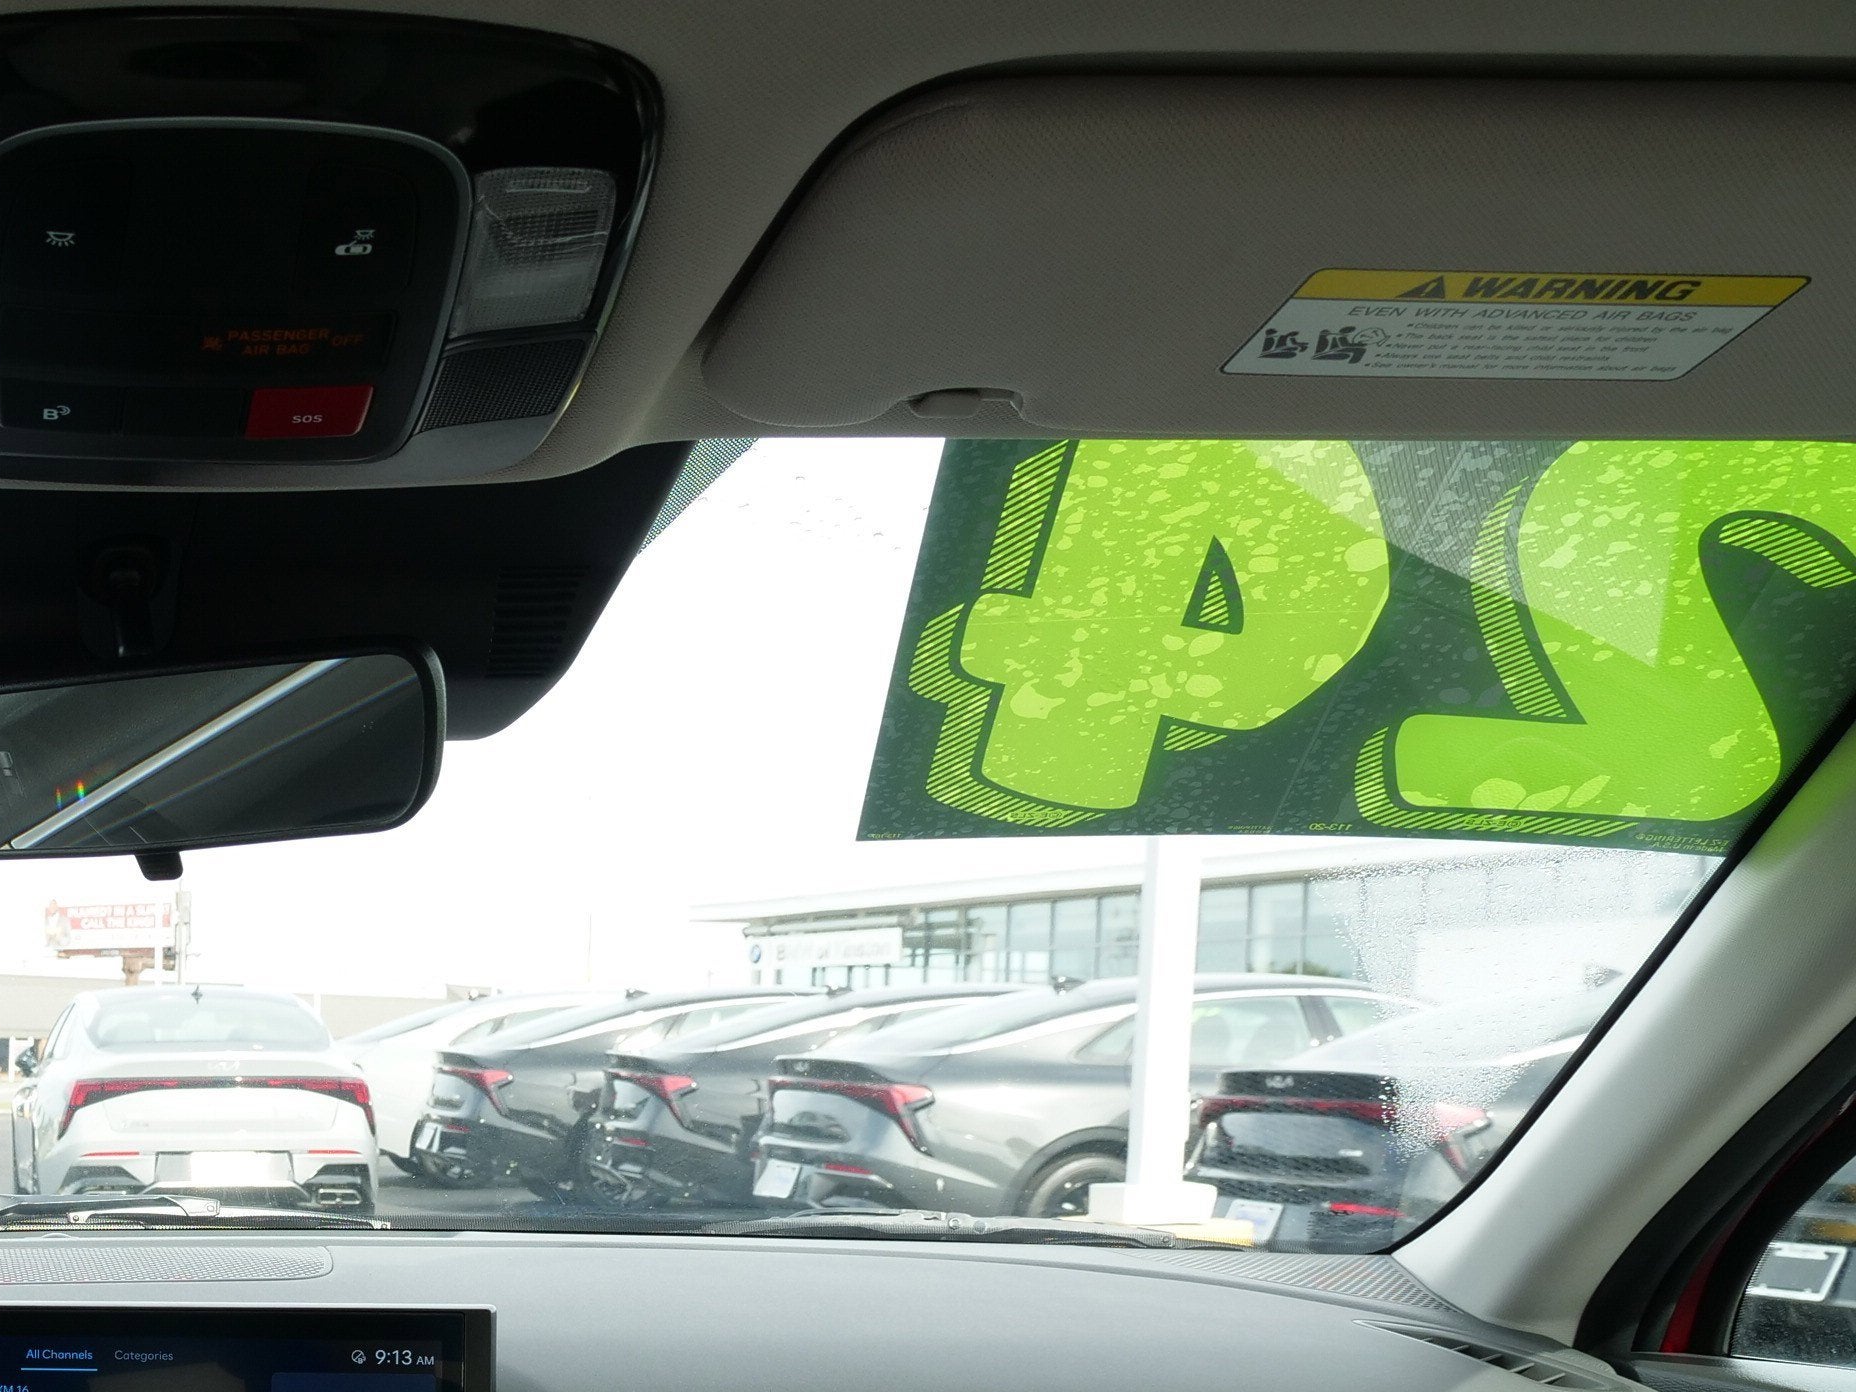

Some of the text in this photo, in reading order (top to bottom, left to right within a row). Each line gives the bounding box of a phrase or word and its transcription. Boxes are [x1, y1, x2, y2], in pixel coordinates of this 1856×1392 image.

[1462, 276, 1701, 301] WARNING
[1347, 306, 1698, 321] EVEN WITH ADVANCED AIR BAGS
[228, 328, 365, 345] PASSENGER OFF
[241, 344, 310, 355] AIR BAG
[291, 414, 324, 423] SOS
[26, 1349, 93, 1360] All Channels
[114, 1350, 174, 1362] Categories
[375, 1350, 435, 1365] 9:13 AM
